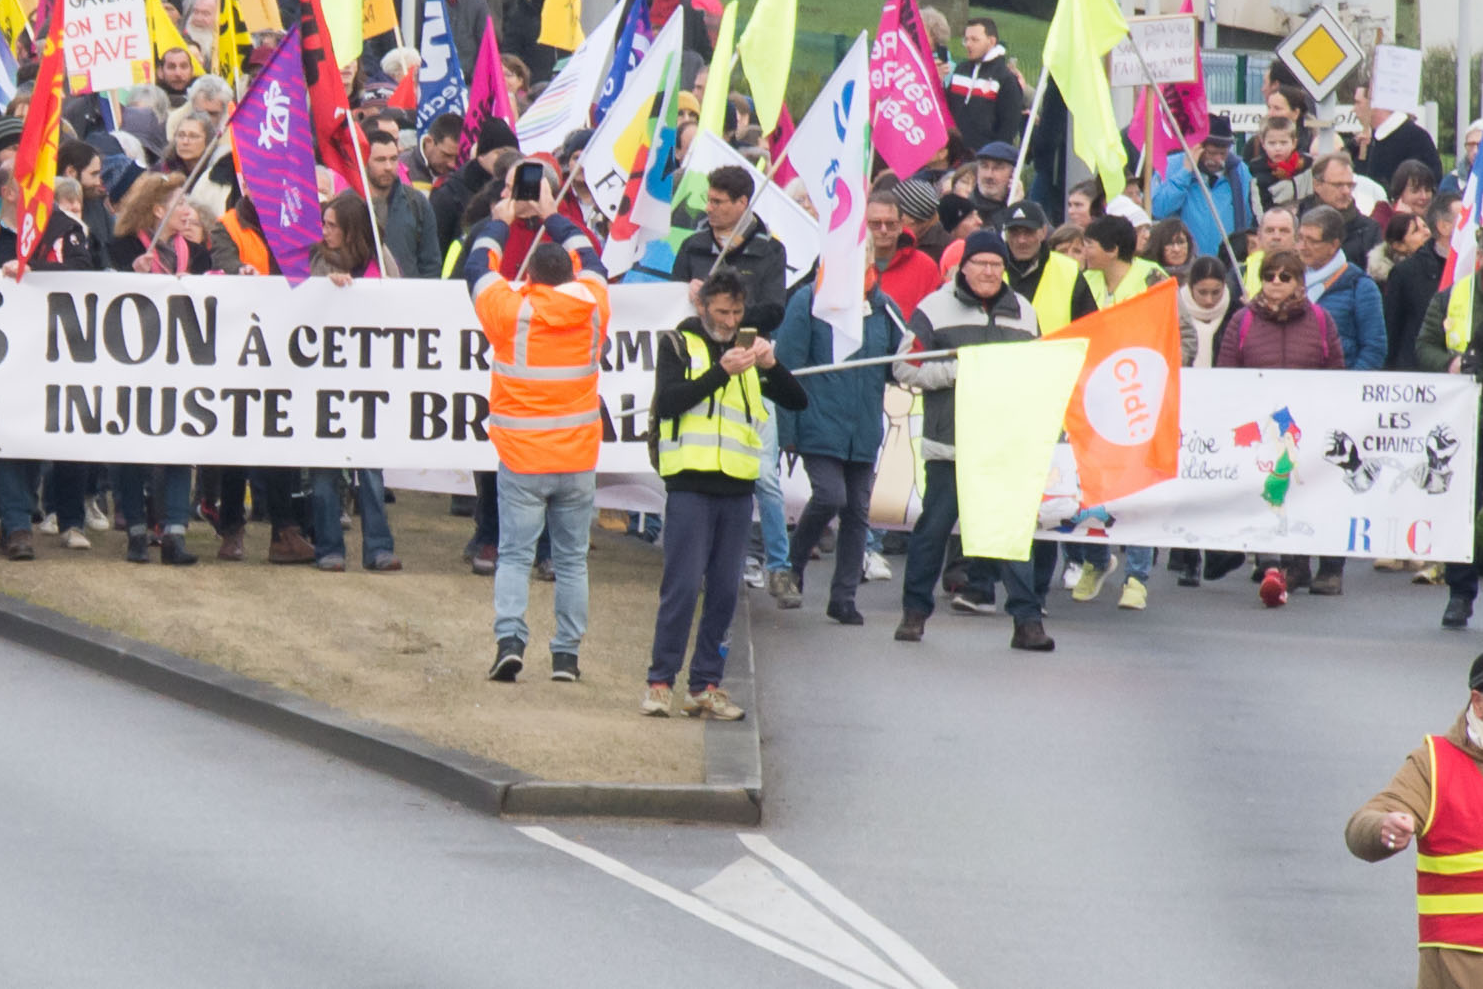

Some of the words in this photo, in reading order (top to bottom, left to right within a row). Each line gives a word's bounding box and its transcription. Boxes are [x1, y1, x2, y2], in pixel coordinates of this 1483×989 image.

[65, 17, 92, 39] ON
[105, 11, 132, 30] EN
[72, 35, 138, 69] BAVE
[45, 291, 218, 366] NON
[237, 312, 272, 367] À
[288, 324, 442, 370] CETTE
[1361, 384, 1437, 404] BRISONS
[45, 384, 294, 437] INJUSTE
[315, 388, 390, 440] ET
[1378, 412, 1411, 430] LES
[1363, 435, 1425, 453] CHAINES
